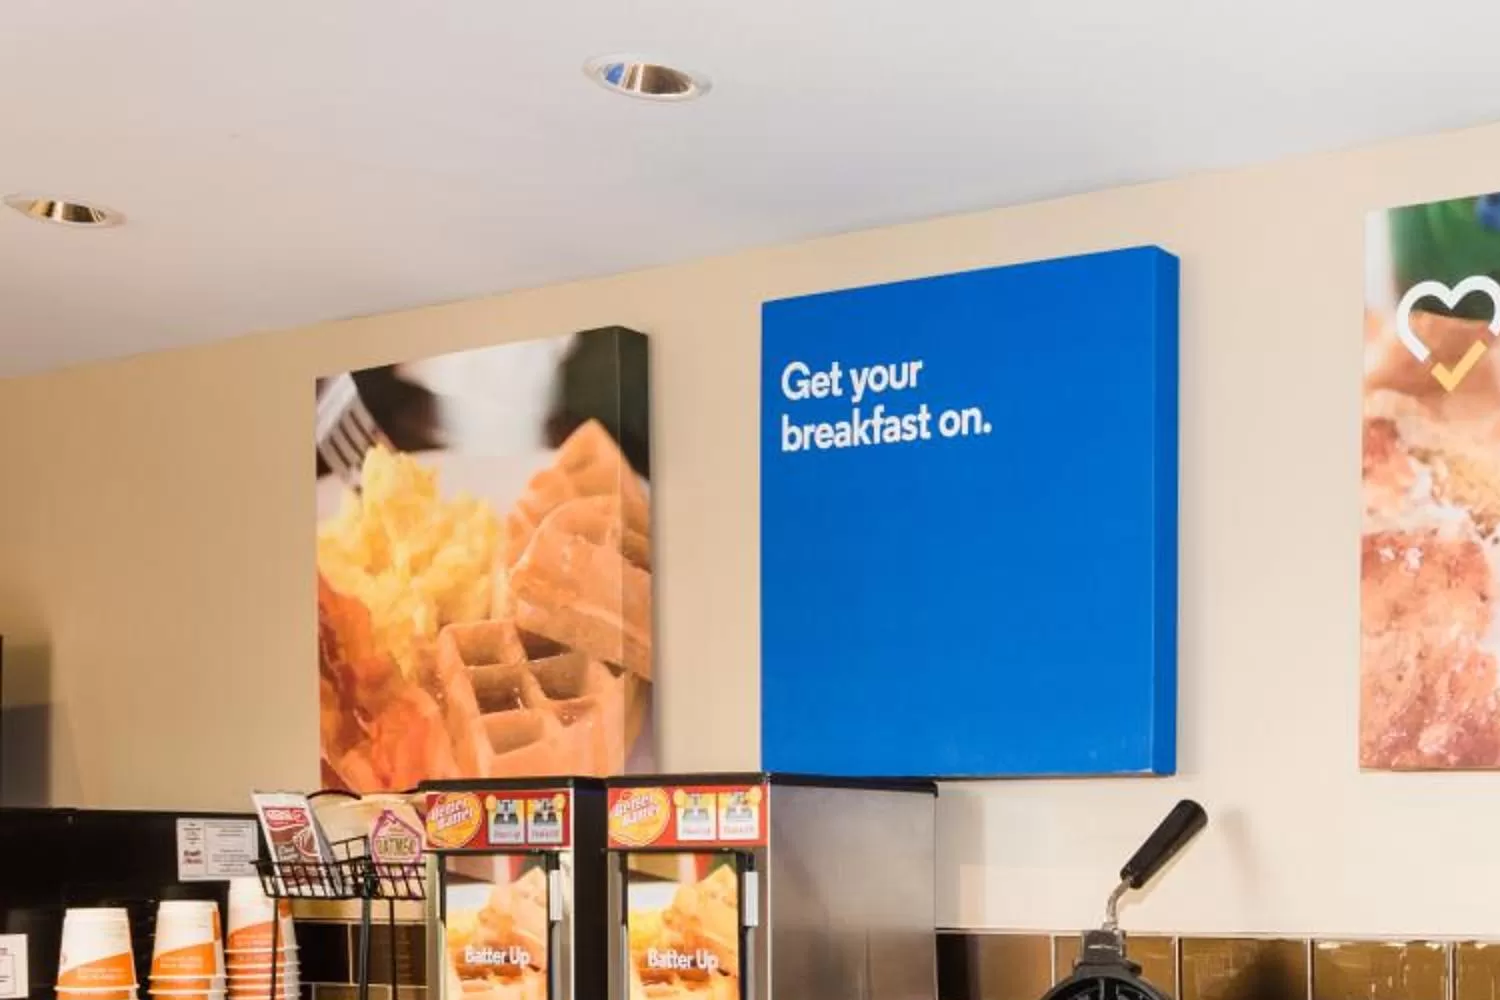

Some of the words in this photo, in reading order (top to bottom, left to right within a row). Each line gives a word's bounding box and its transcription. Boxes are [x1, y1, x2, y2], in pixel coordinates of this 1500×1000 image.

[781, 361, 843, 401] Get
[849, 359, 924, 404] your
[781, 404, 932, 452] breakfast
[938, 407, 993, 438] on.
[464, 945, 507, 965] Batter
[509, 945, 531, 968] Up
[647, 947, 693, 968] Batter
[696, 950, 719, 971] Up
